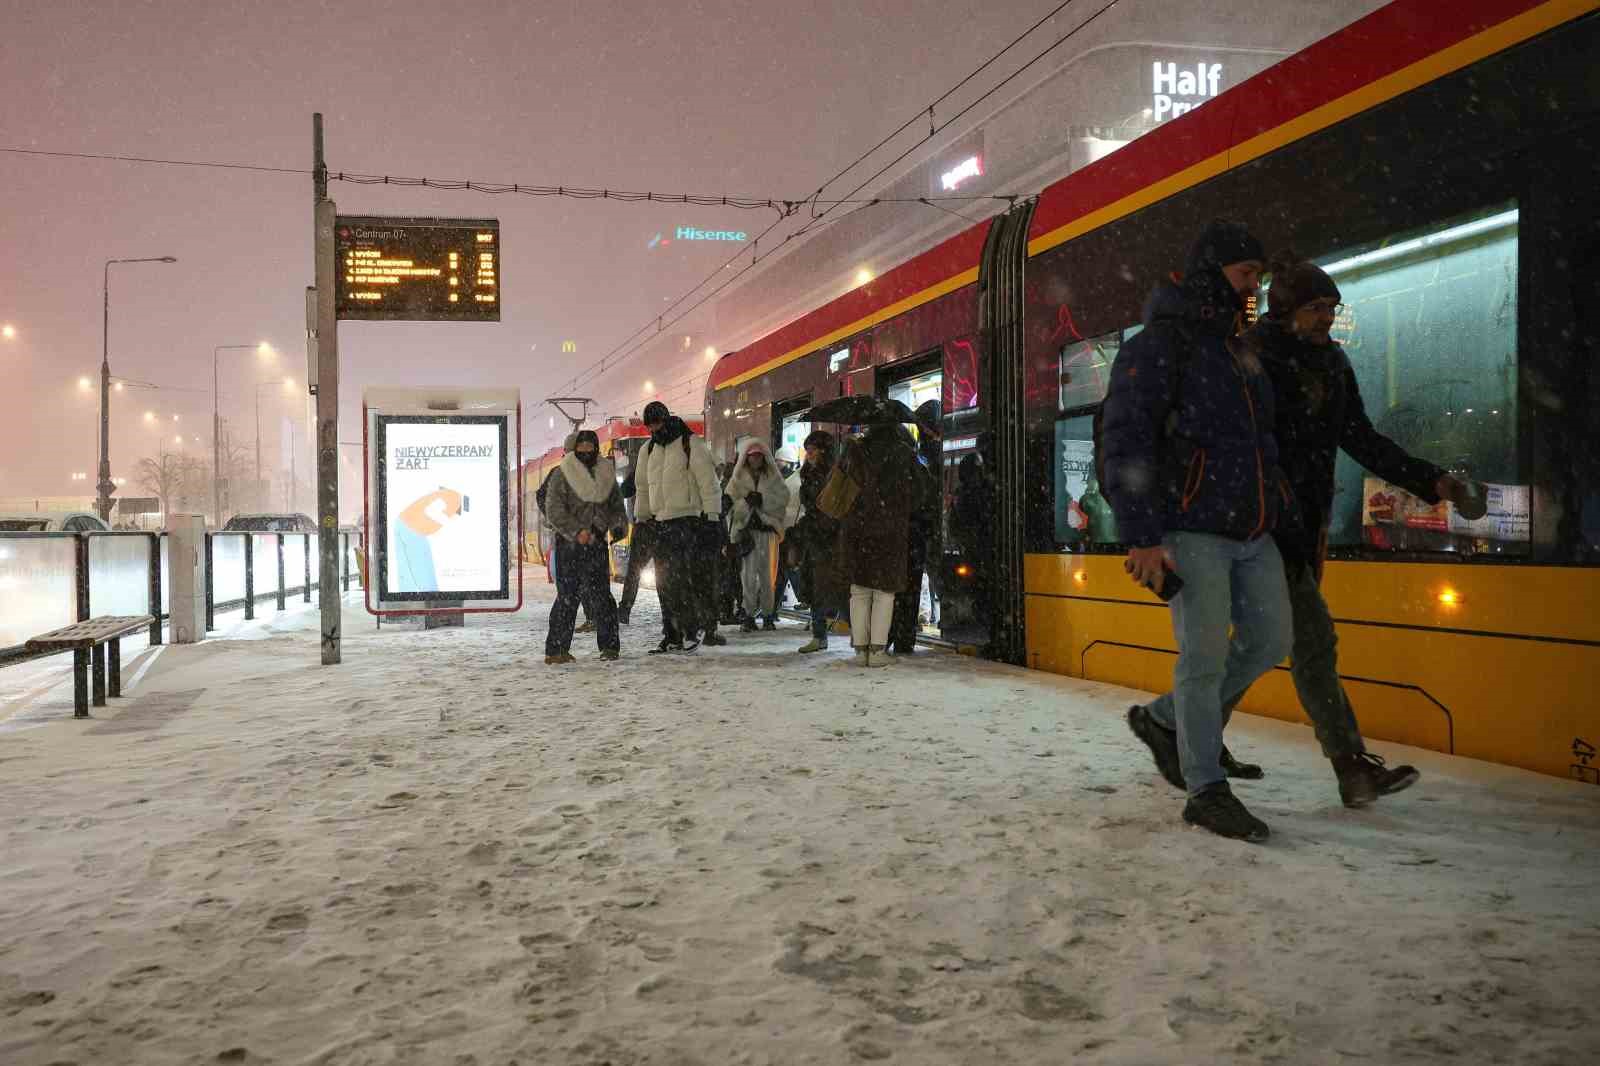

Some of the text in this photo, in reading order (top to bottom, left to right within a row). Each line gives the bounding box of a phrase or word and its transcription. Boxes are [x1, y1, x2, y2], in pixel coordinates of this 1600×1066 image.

[1153, 62, 1222, 96] Half
[1154, 94, 1203, 122] Pr
[355, 228, 391, 239] Centrum
[676, 227, 747, 241] Hisense
[394, 443, 494, 458] NIEWYCZERPANY
